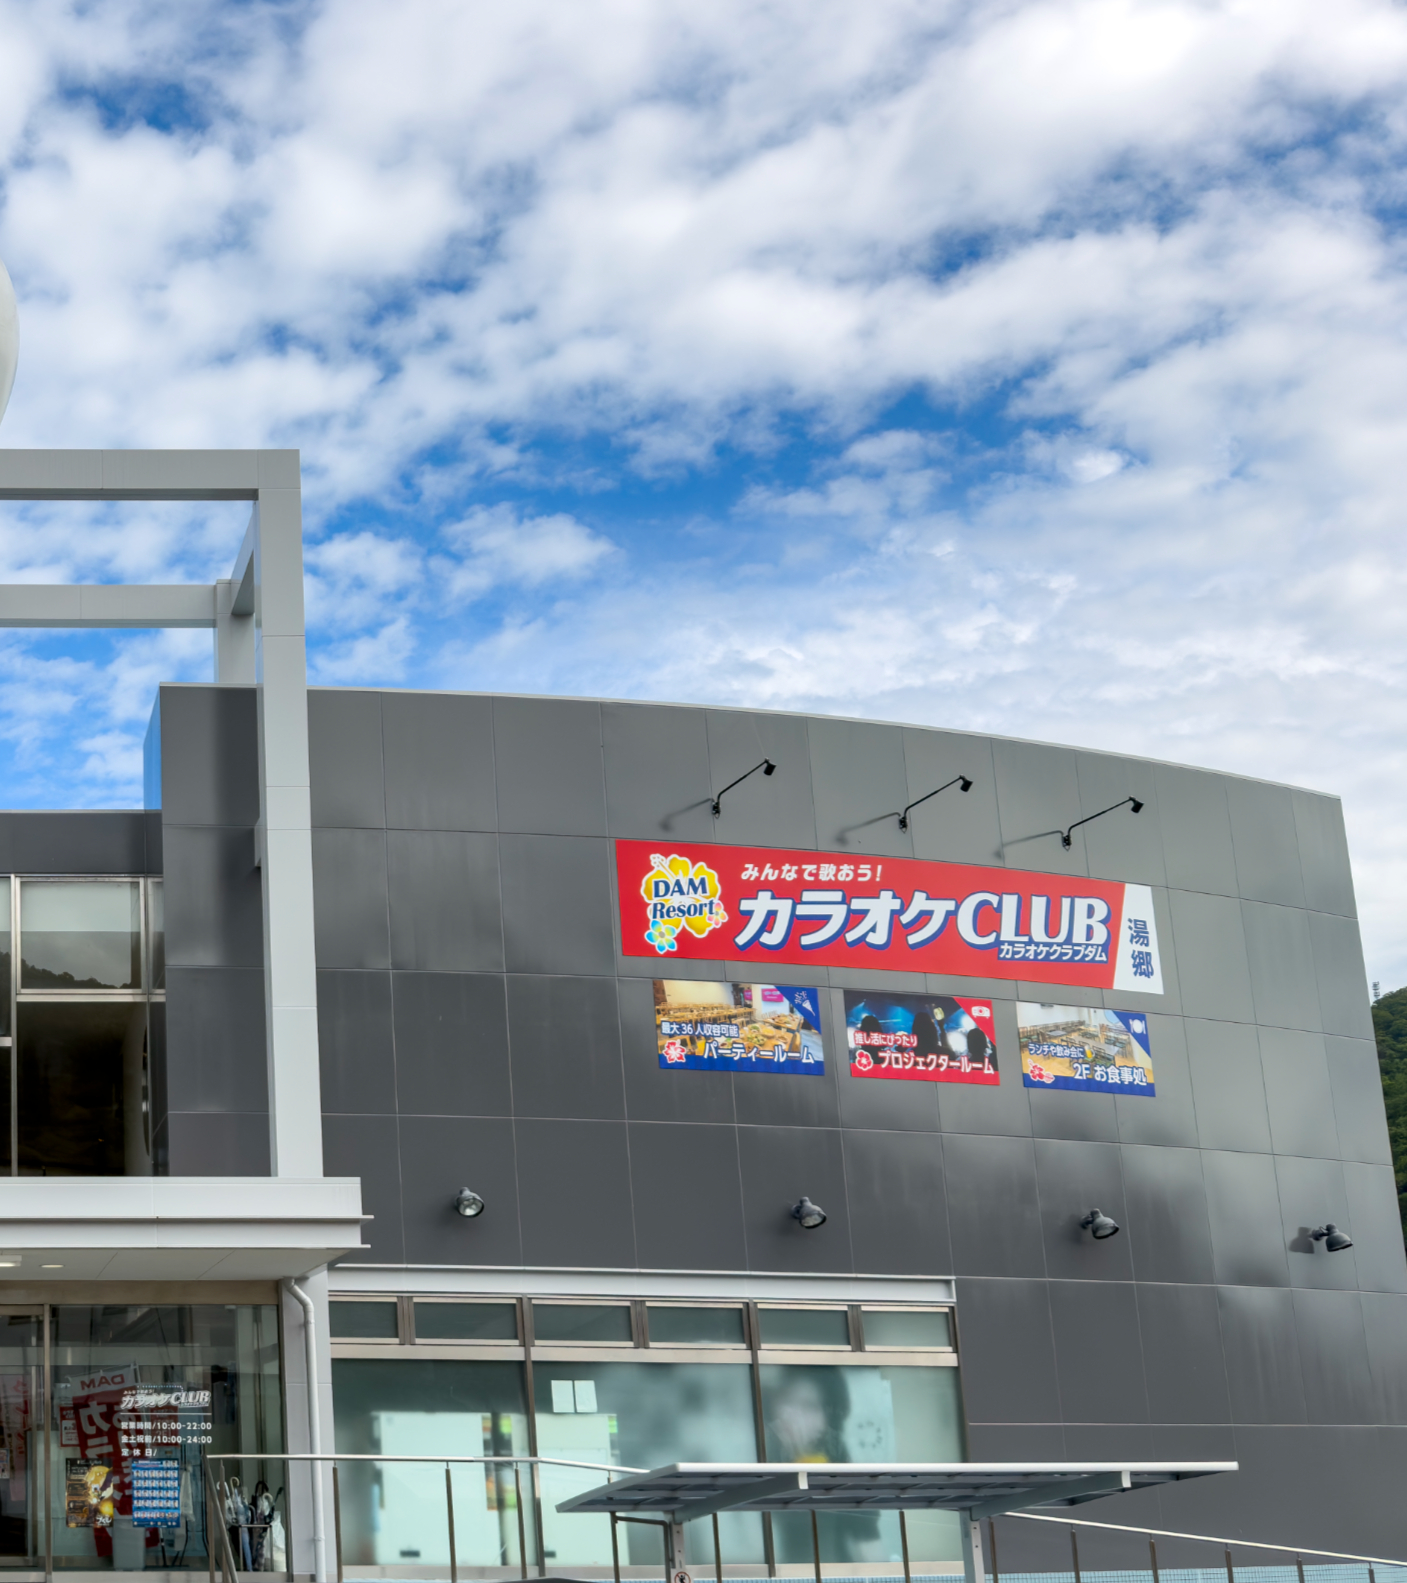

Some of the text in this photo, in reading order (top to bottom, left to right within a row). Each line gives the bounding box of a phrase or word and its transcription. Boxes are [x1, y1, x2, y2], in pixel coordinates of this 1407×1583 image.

[653, 876, 709, 899] DAM
[651, 898, 716, 920] Resort
[999, 942, 1108, 962] カラオケクラブダム
[1127, 917, 1155, 979] 湯郷
[703, 1041, 815, 1064] パーティールーム
[878, 1051, 995, 1075] プロジェクタールーム
[1093, 1064, 1148, 1086] お食事処
